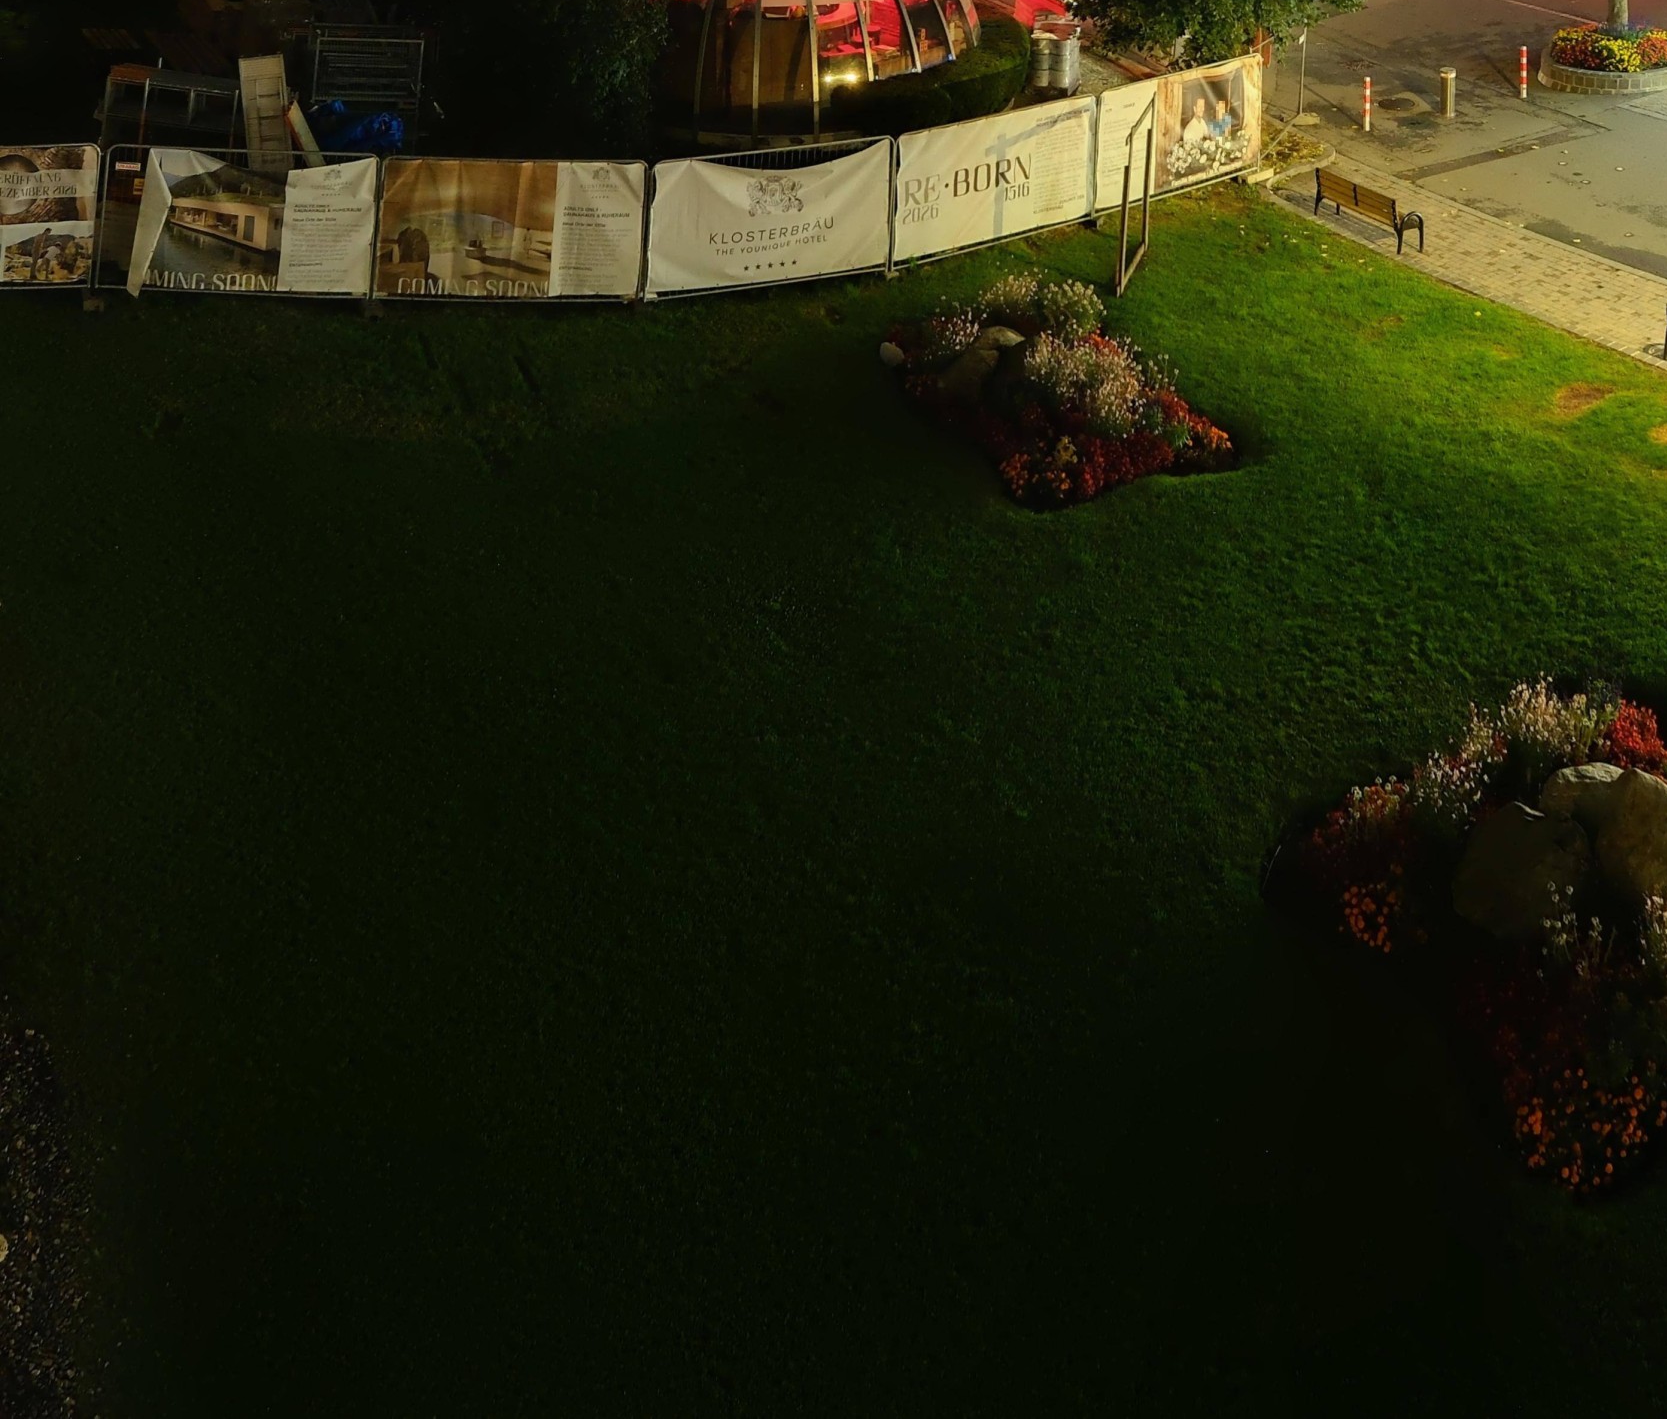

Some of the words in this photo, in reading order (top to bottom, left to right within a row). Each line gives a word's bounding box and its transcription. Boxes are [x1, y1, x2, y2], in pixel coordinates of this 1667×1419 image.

[1004, 181, 1030, 202] 1516
[902, 202, 940, 226] 2026
[708, 216, 835, 245] KLOSTERBRÄU
[715, 247, 735, 256] THE
[740, 240, 792, 254] YOUNIQUE
[795, 233, 828, 244] HOTEL
[144, 269, 206, 290] MING
